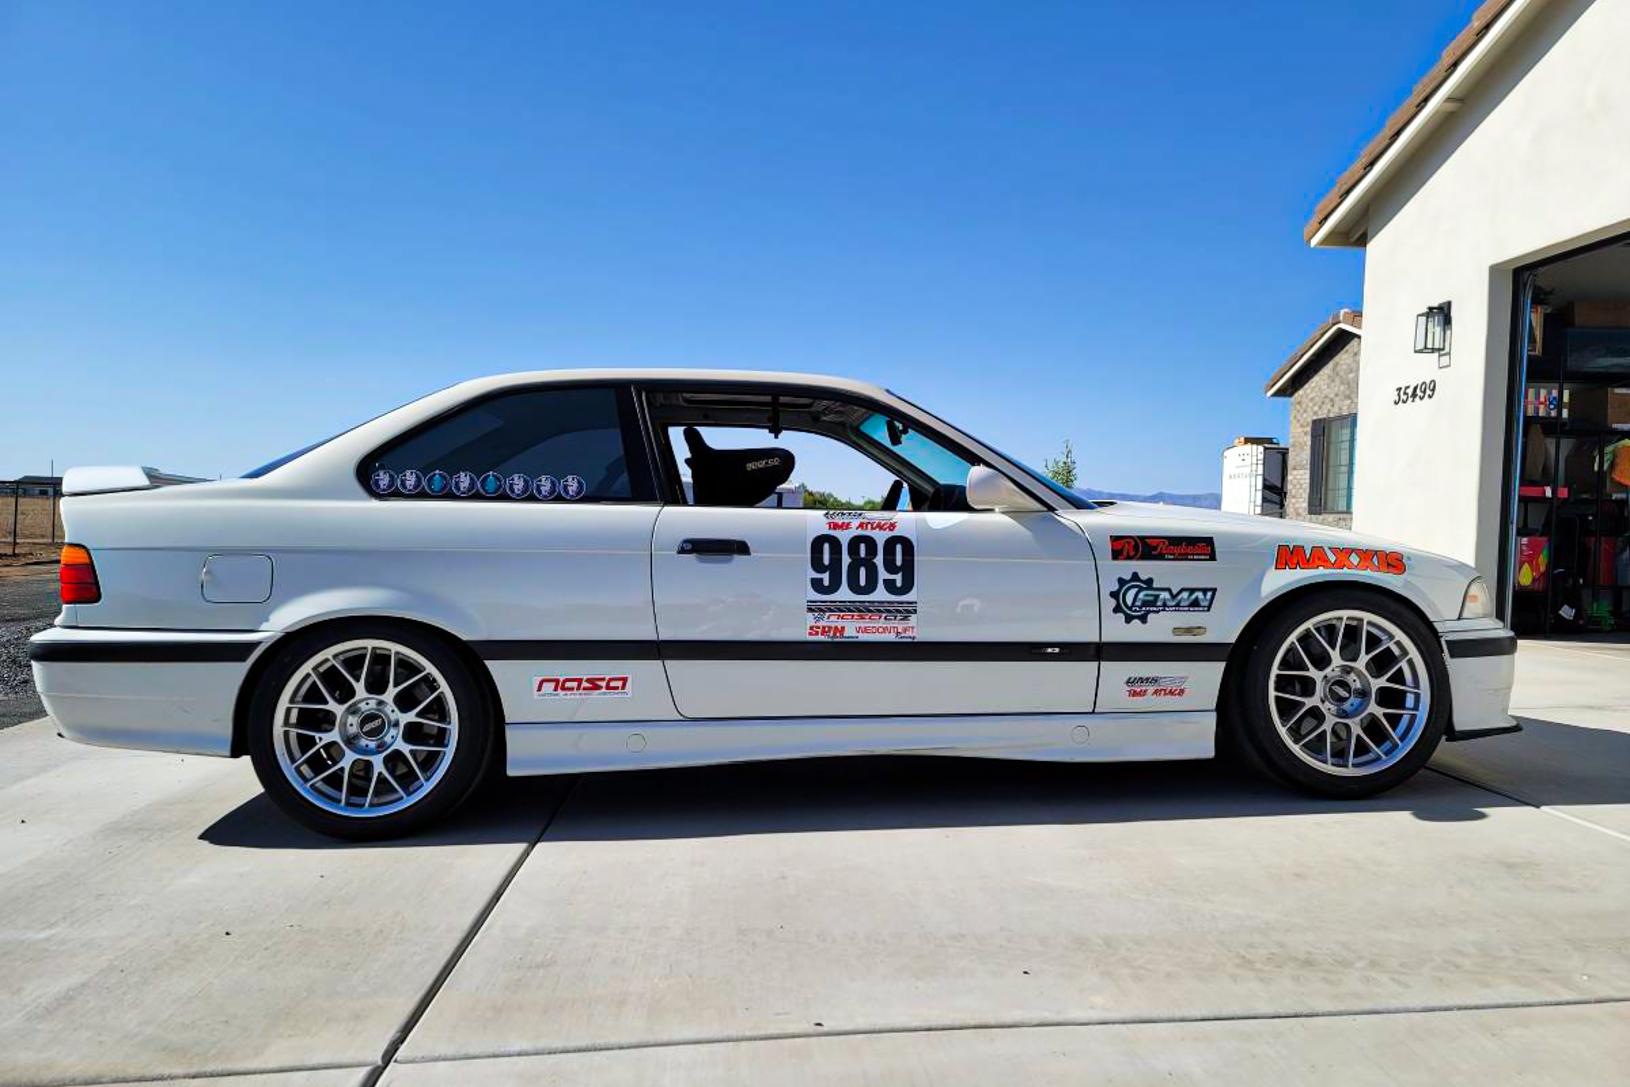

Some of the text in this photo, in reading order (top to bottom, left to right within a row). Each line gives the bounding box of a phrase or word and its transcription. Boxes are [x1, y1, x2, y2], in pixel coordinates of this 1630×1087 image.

[1393, 379, 1437, 406] 35499
[810, 533, 915, 596] 989
[1275, 544, 1407, 576] MAXXIS
